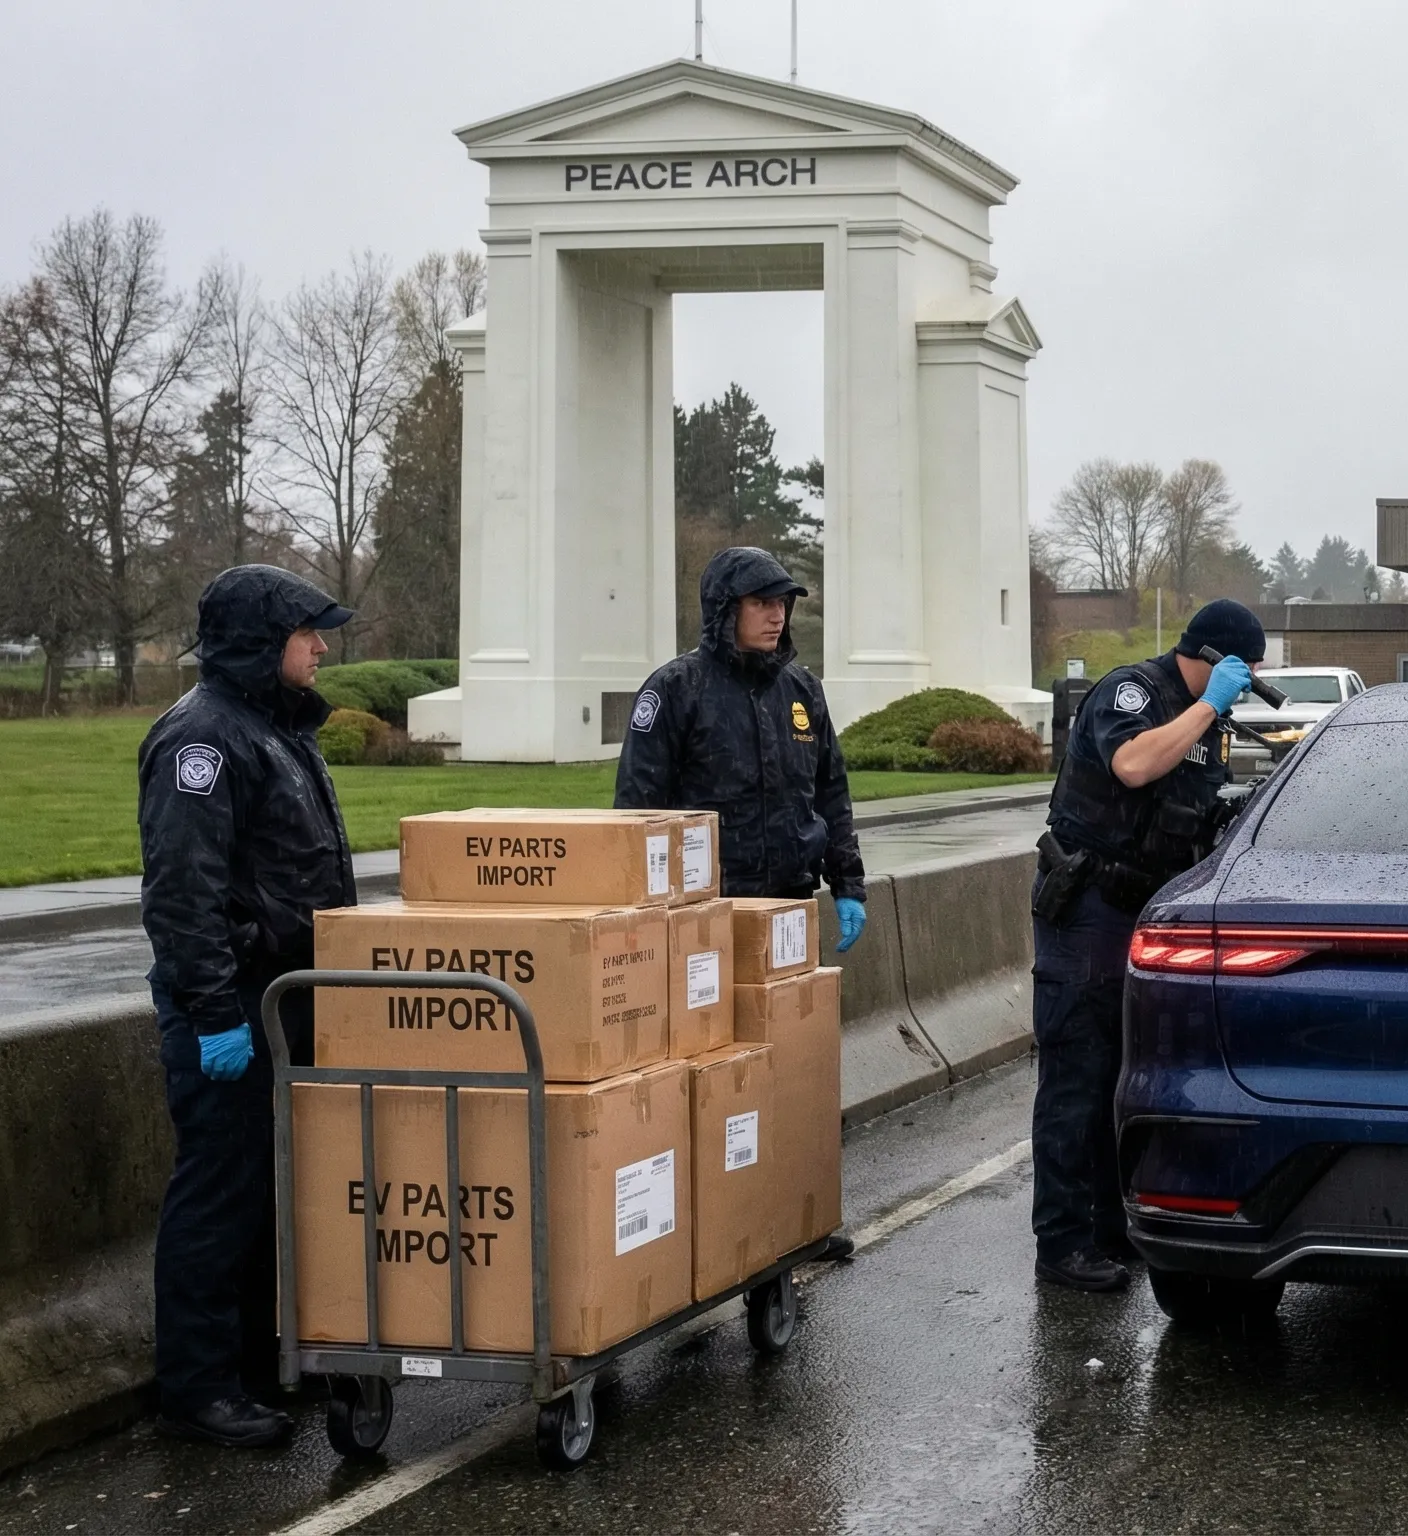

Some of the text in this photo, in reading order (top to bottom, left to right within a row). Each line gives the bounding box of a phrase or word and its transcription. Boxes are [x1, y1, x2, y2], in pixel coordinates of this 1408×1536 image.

[565, 157, 816, 191] PEACE ARCH
[466, 837, 566, 859] EV PARTS
[477, 865, 556, 887] IMPORT
[425, 948, 535, 983] PARTS
[388, 996, 513, 1031] IMPORT
[348, 1180, 515, 1221] EV PARTS
[376, 1229, 498, 1266] MPORT
